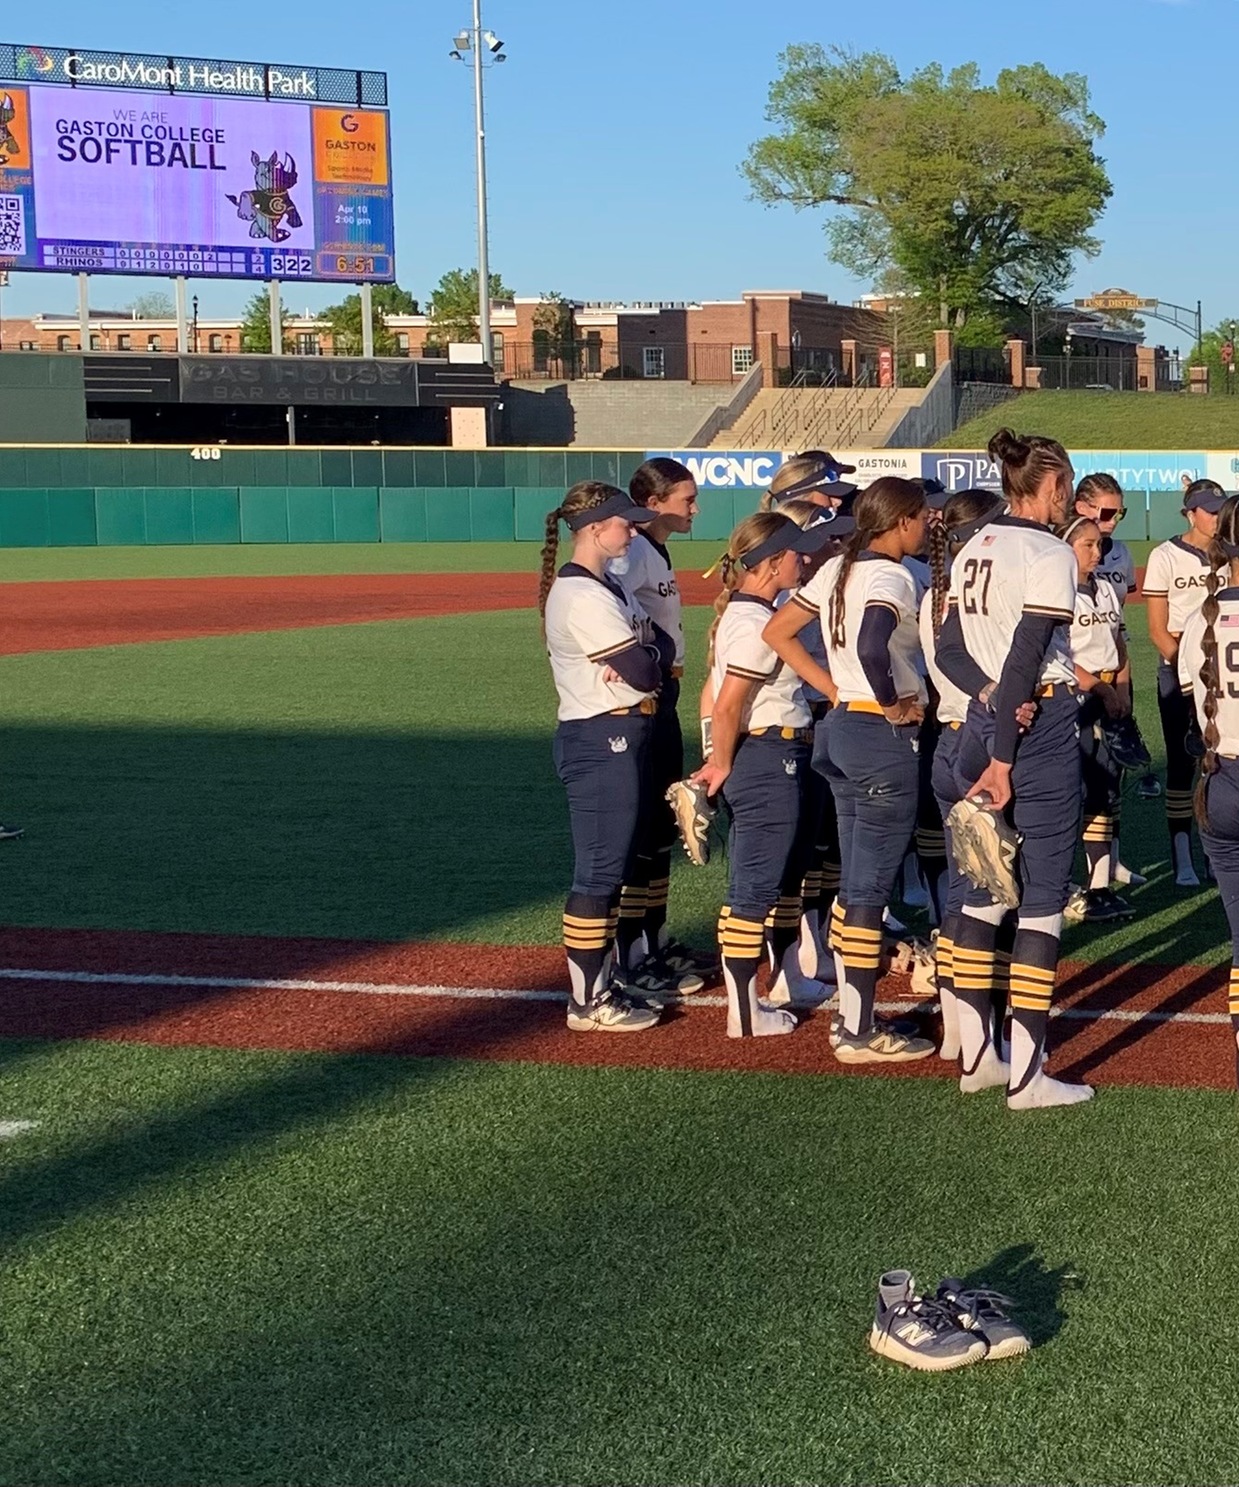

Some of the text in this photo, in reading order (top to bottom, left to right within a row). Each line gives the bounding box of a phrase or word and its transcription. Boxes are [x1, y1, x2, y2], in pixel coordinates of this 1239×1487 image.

[64, 56, 316, 95] CaroMont Health Park
[113, 109, 168, 123] WE ARE
[56, 119, 226, 144] GASTON COLLEGE
[325, 139, 376, 152] GASTON
[57, 135, 227, 171] SOFTBALL
[338, 204, 368, 214] Apr 10
[335, 215, 354, 224] 2:00
[53, 246, 105, 256] STINGERS
[56, 257, 103, 267] RHINOS
[273, 258, 311, 272] 3 2 2
[337, 256, 374, 273] 6:51
[193, 363, 401, 385] GAS HOUSE
[213, 387, 377, 401] BAR & GRILL
[191, 448, 220, 460] 400
[859, 459, 907, 468] GASTONIA
[963, 558, 993, 616] 27
